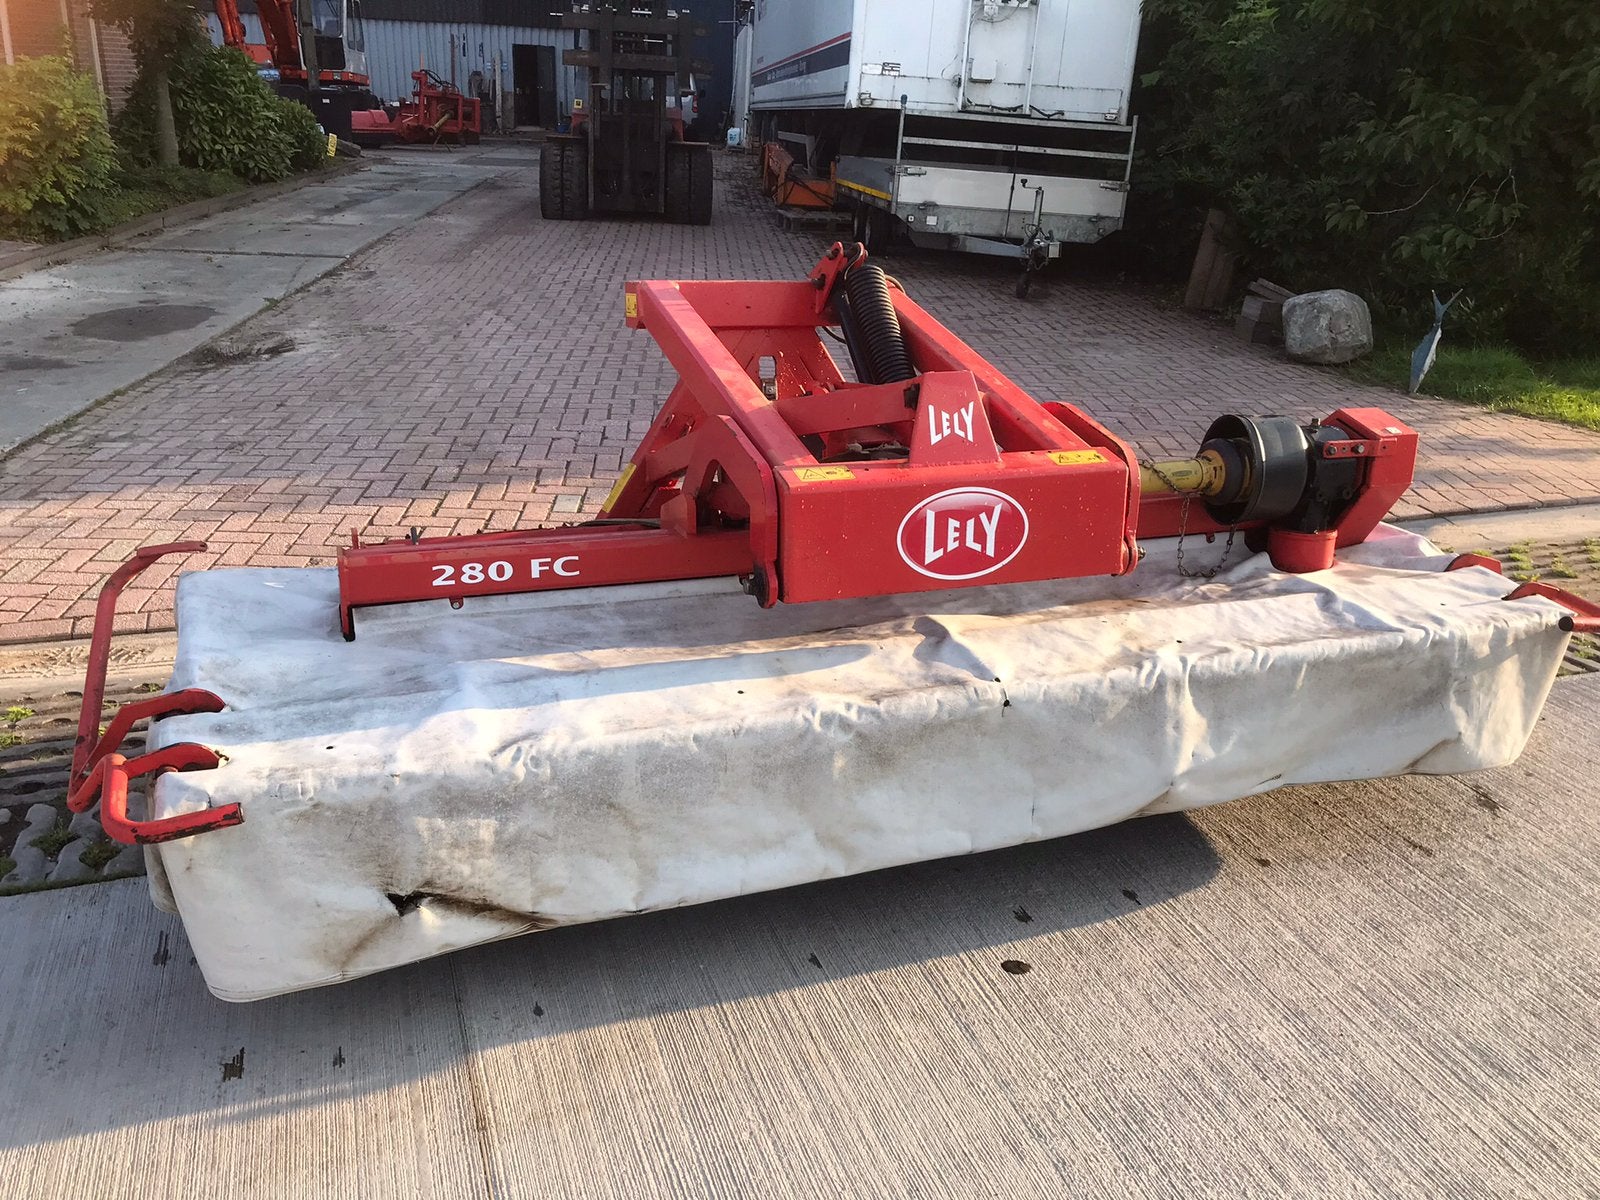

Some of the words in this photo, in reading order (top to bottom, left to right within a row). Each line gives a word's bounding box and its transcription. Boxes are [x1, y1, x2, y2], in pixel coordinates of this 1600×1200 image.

[928, 401, 974, 446] LELY
[924, 503, 1003, 566] LELY
[432, 560, 514, 587] 280
[530, 555, 580, 579] FC
